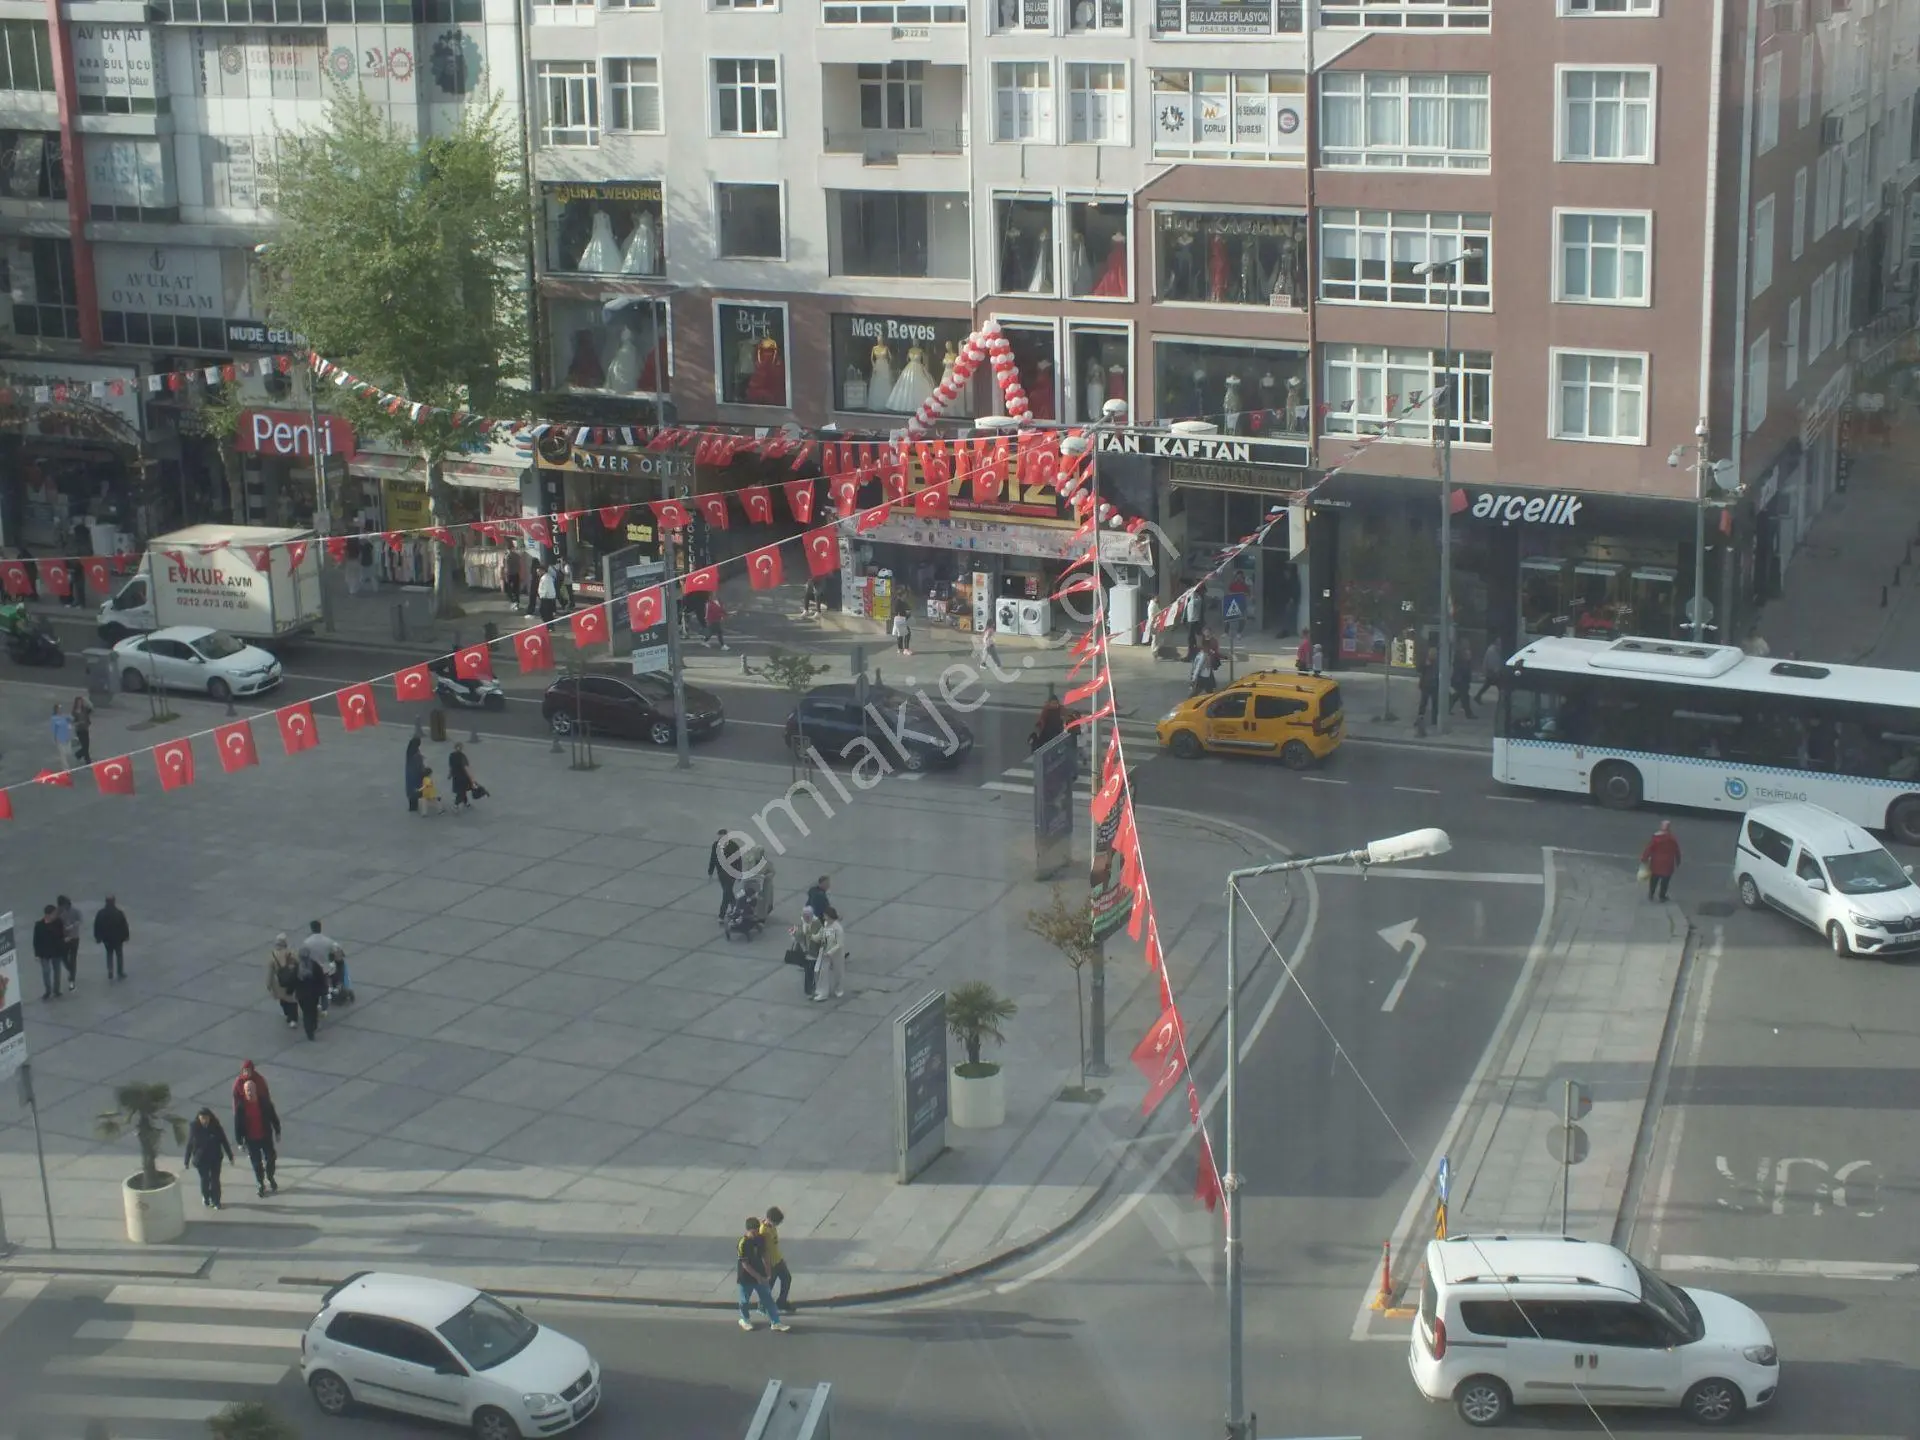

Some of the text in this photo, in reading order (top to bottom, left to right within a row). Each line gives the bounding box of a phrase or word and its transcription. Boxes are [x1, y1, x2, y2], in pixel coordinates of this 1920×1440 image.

[1190, 11, 1204, 22] BUZ
[1205, 12, 1227, 22] LAZER
[1229, 10, 1269, 23] EPİLASYON
[1204, 124, 1261, 134] ÇORLU ŞUBESİ
[127, 273, 193, 290] AVUKAT
[112, 290, 145, 305] OYA
[229, 326, 263, 341] NUDE
[851, 318, 935, 341] Mes Reves
[1154, 437, 1250, 461] KAFTAN
[1472, 493, 1583, 526] arçelik
[168, 565, 252, 587] EVKUR AVM
